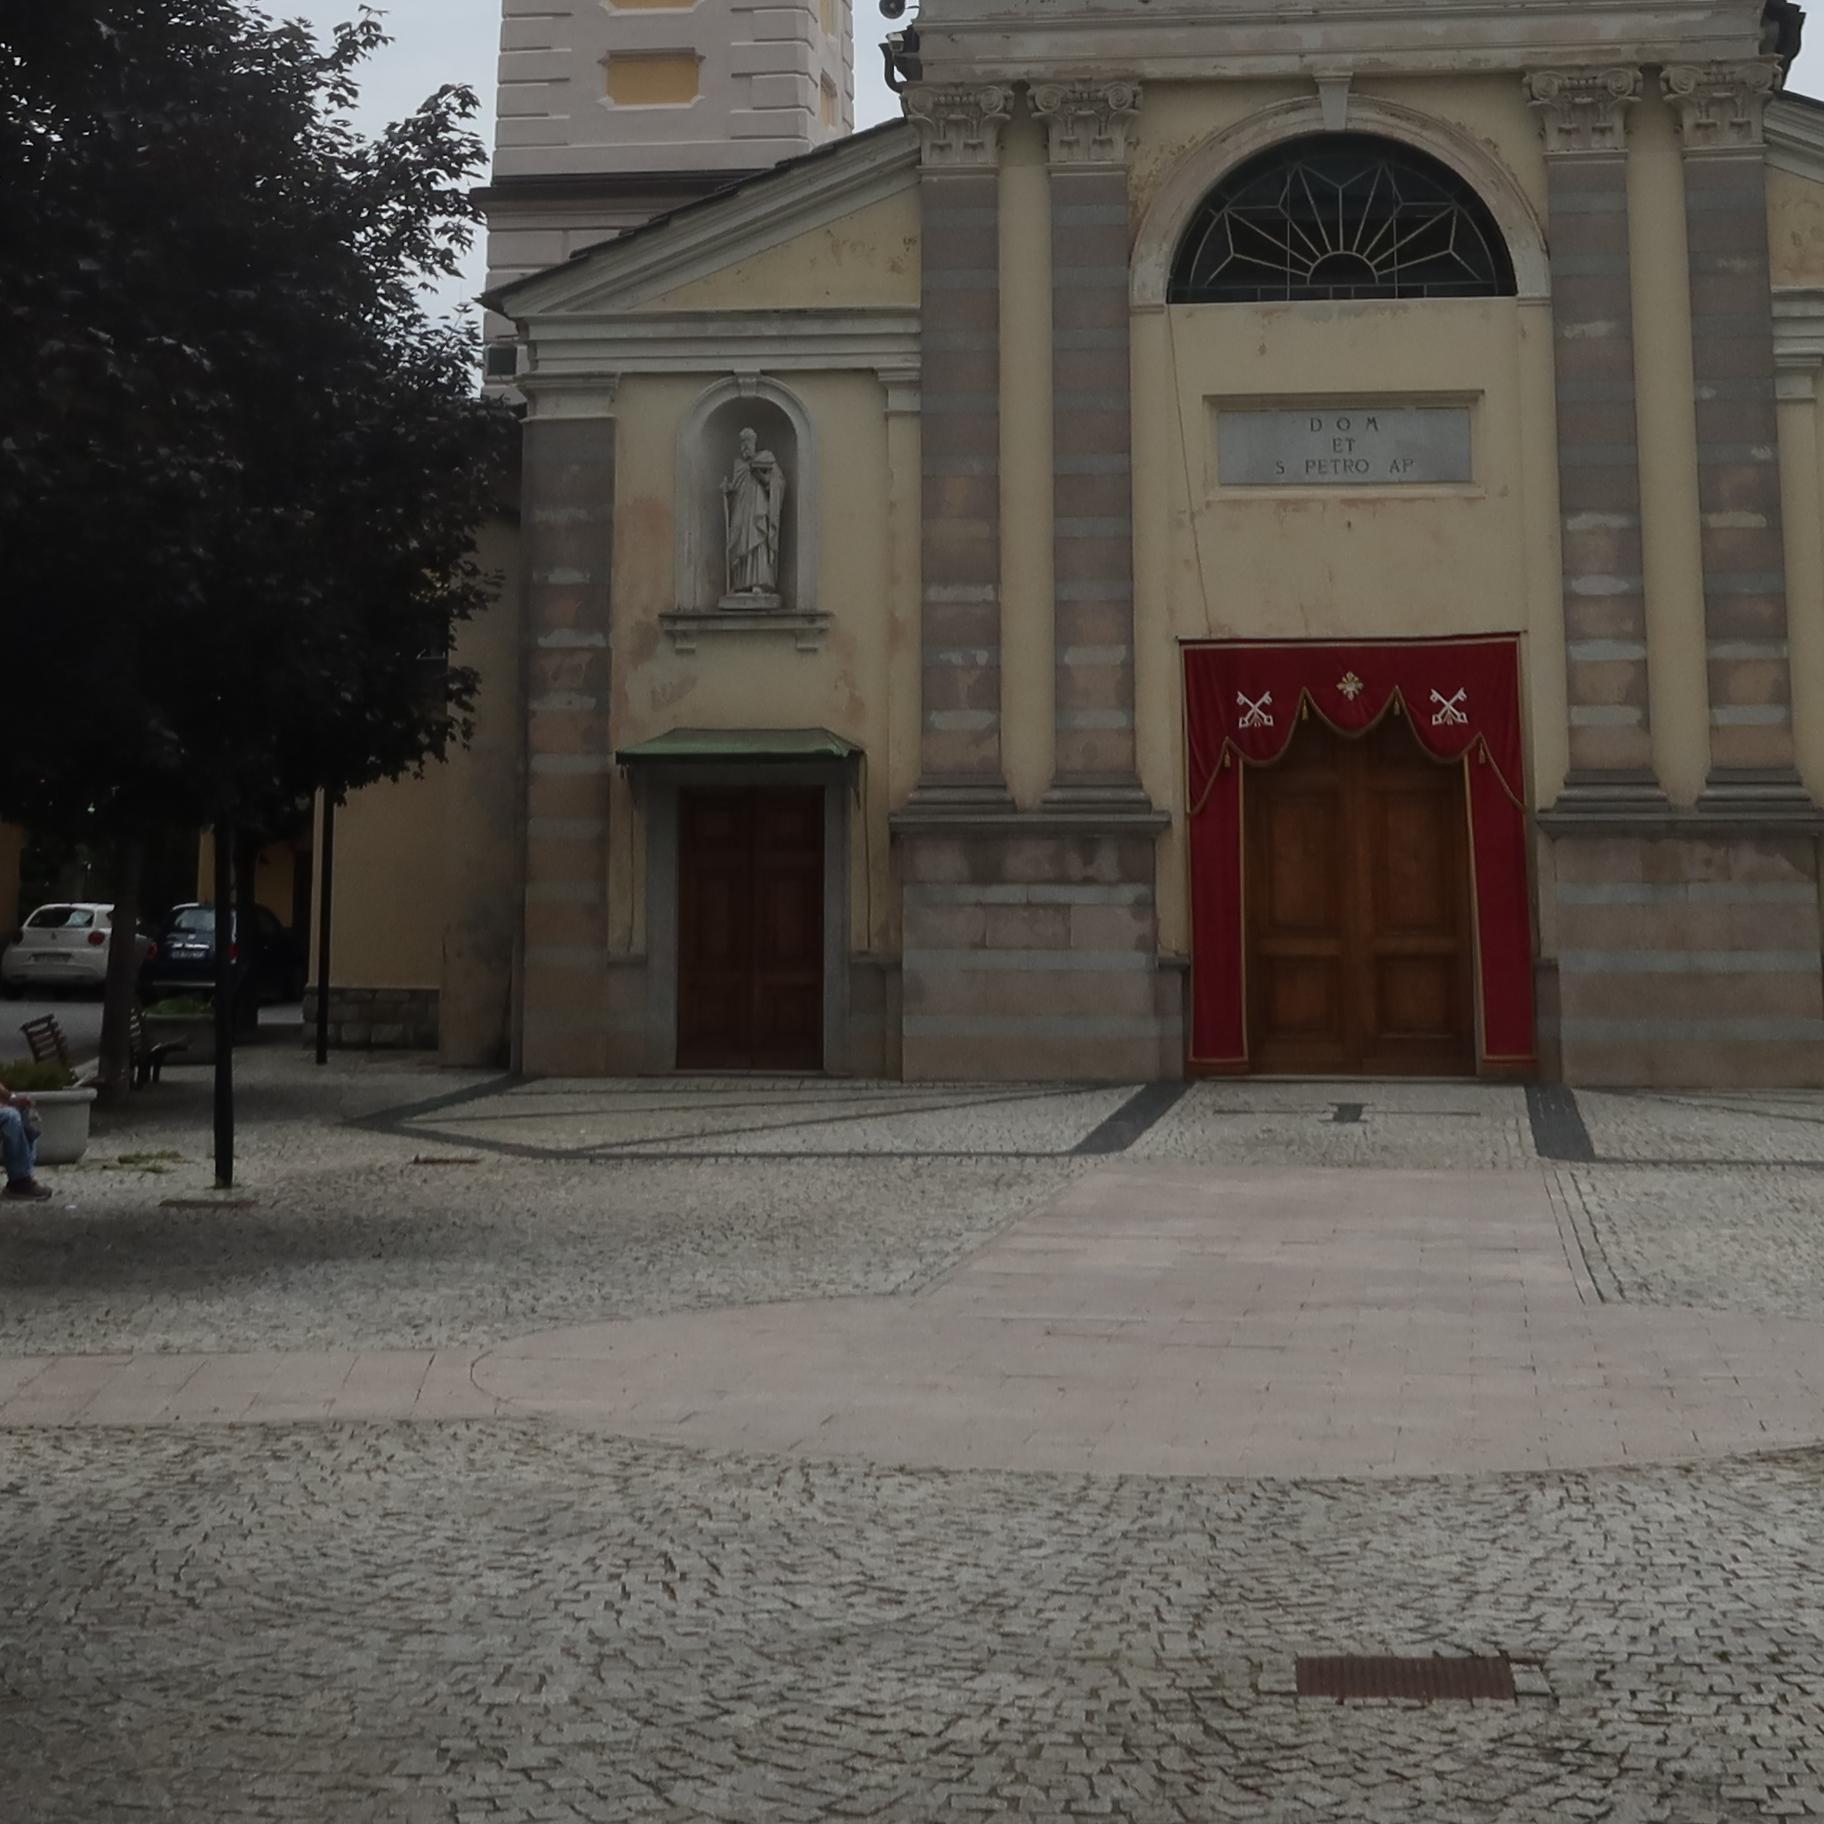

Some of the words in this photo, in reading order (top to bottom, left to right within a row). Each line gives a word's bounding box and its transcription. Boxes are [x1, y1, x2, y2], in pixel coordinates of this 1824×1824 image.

[1332, 438, 1356, 453] ET
[1275, 459, 1285, 474] S
[1305, 458, 1370, 475] PETRO
[1389, 458, 1414, 474] AP
